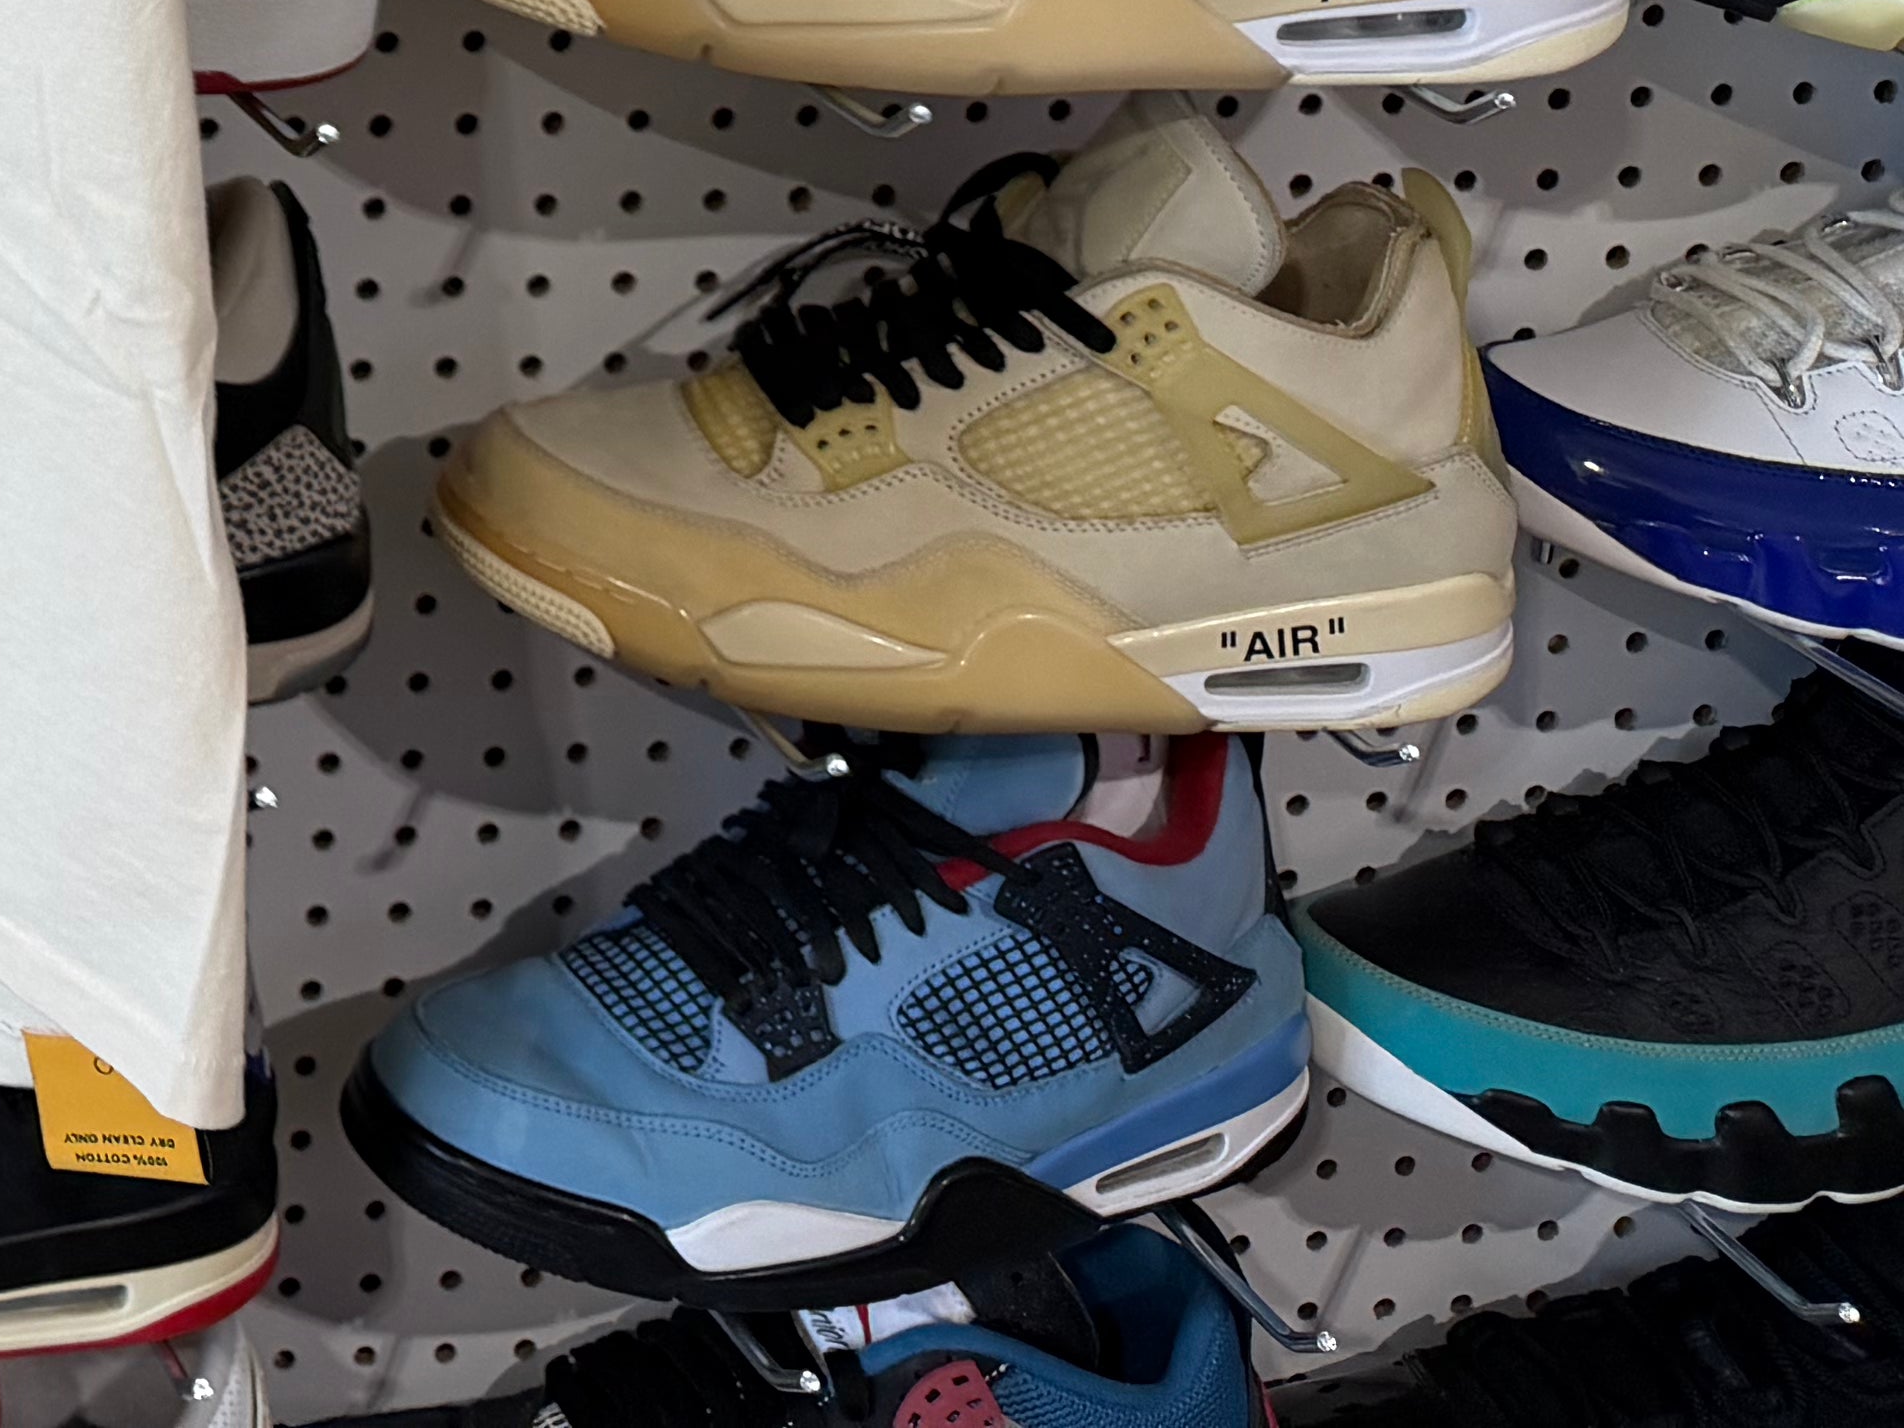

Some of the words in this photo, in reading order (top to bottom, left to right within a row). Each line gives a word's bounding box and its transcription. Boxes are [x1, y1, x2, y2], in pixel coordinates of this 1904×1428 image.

[1220, 616, 1345, 662] "AIR"
[64, 1132, 99, 1145] ONLY
[102, 1135, 146, 1147] CLEAN
[150, 1137, 176, 1149] DRY
[75, 1152, 132, 1164] COTTON
